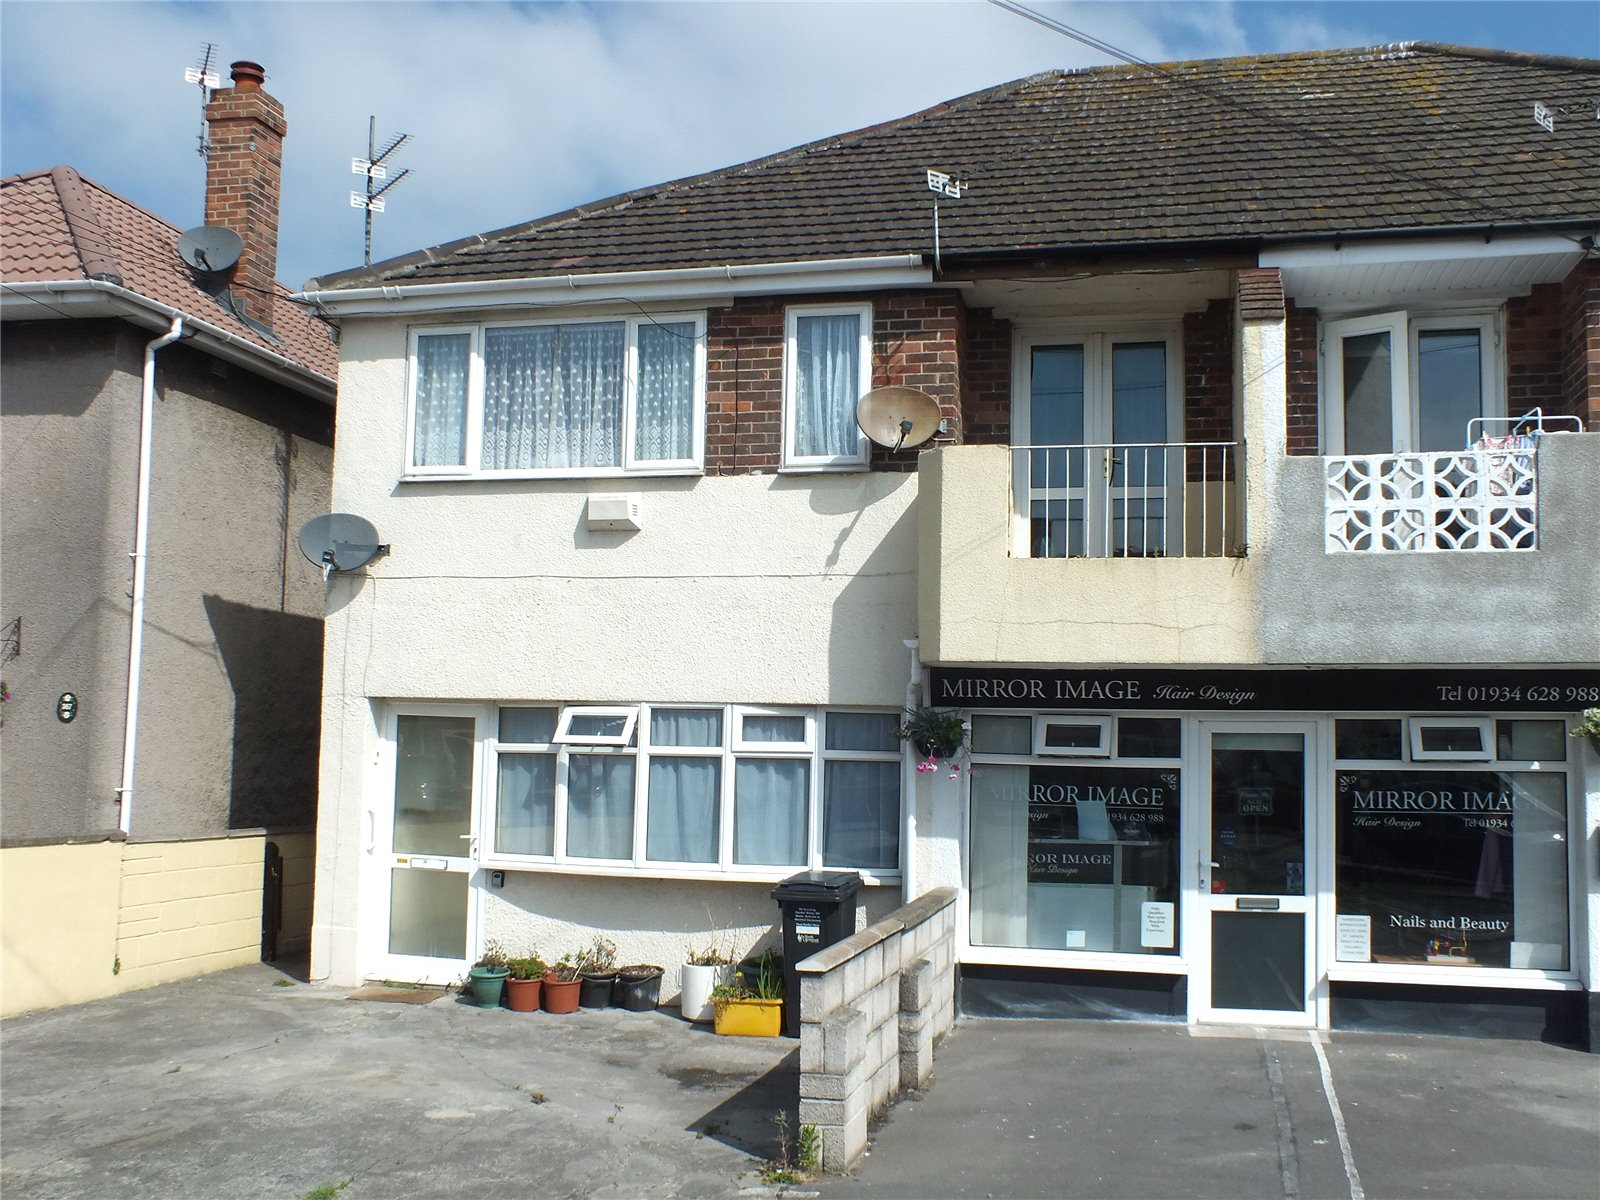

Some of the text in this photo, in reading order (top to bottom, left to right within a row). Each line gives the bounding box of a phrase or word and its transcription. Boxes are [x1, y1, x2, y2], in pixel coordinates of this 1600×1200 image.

[942, 678, 1599, 705] MIRROR IMAGE Hair Design Tel 01934 628 988
[1088, 785, 1164, 806] IMAGE
[1352, 790, 1456, 810] MIRROR
[1242, 804, 1269, 813] OPEN
[1029, 811, 1164, 823] sign 1934 628 988
[1352, 816, 1381, 827] Hair
[1383, 816, 1421, 831] Design
[1464, 818, 1477, 828] Tel
[1478, 818, 1508, 829] 01934
[1062, 854, 1112, 865] IMAGE
[1047, 864, 1079, 877] Design
[1389, 914, 1510, 932] Nails and Beauty
